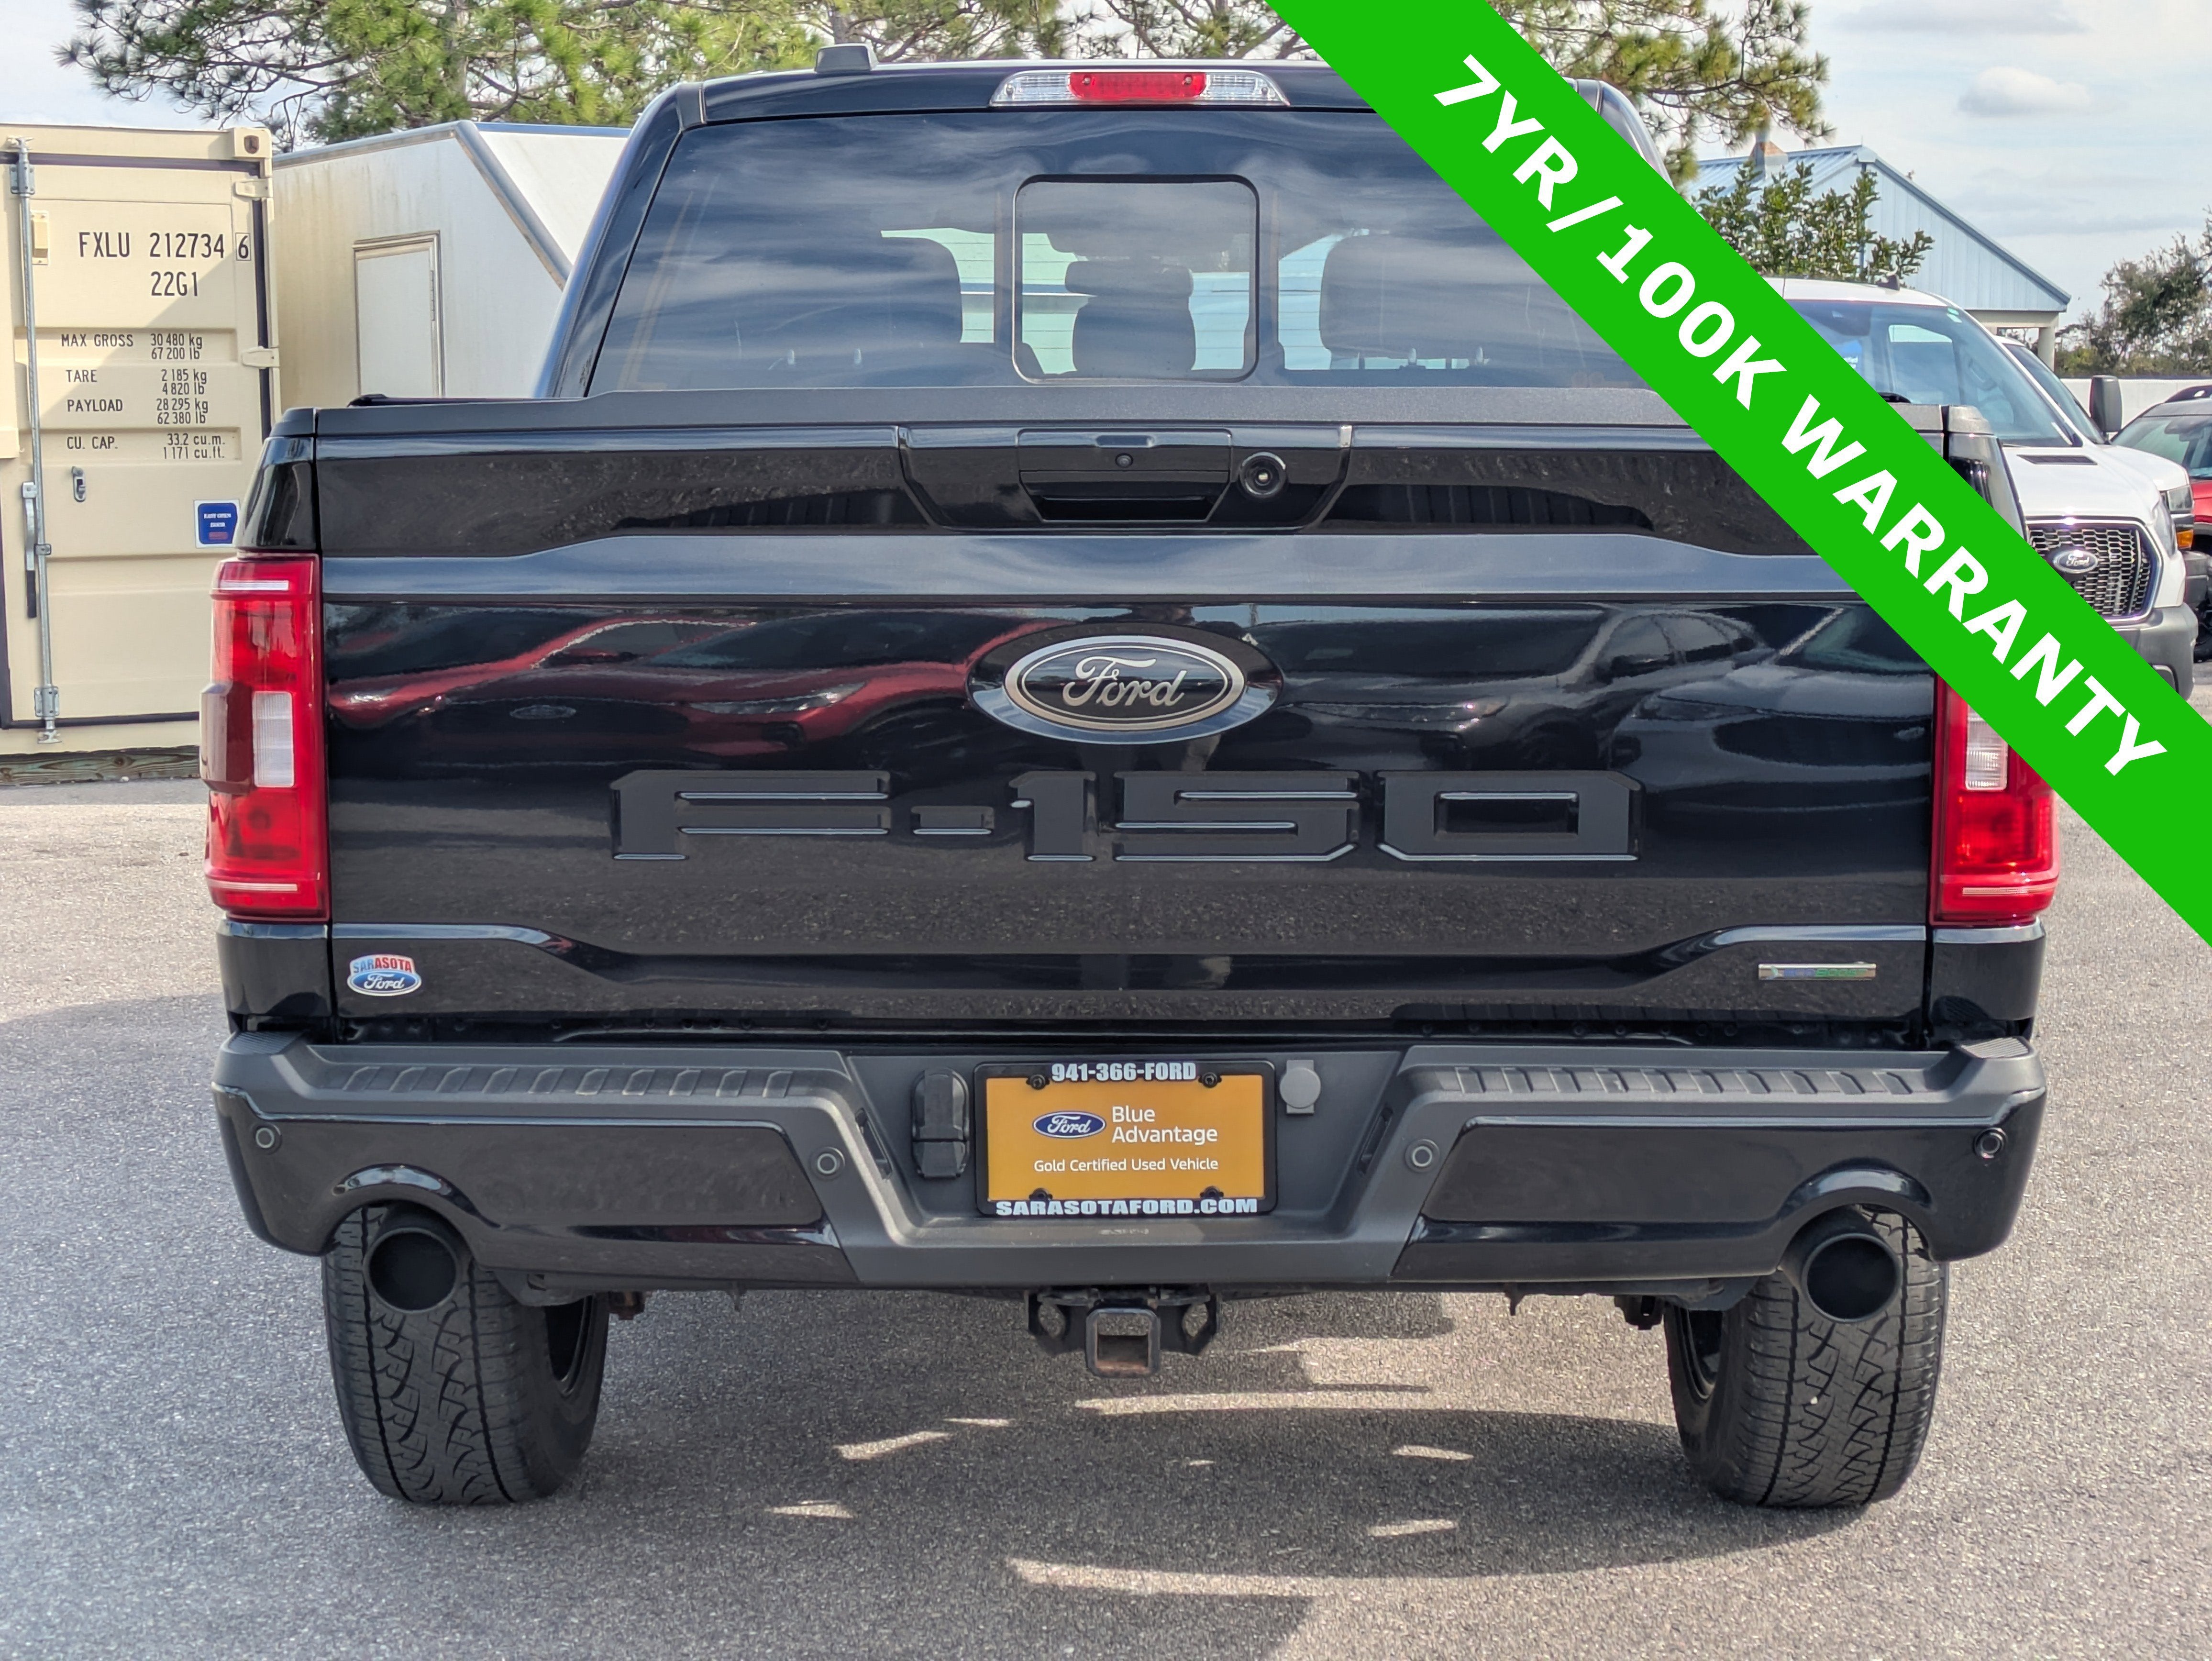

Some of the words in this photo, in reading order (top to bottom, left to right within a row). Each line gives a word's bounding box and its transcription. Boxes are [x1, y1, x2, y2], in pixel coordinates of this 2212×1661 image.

[79, 232, 130, 257] FXLU
[149, 233, 225, 258] 212734
[238, 235, 249, 258] 6
[150, 271, 198, 297] 22G1
[61, 333, 87, 347] MAX
[94, 333, 134, 347] GROSS
[188, 333, 202, 349] kg
[189, 347, 200, 360] lb
[65, 369, 98, 383] TARE
[192, 368, 207, 385] kg
[193, 383, 205, 395] lb
[66, 399, 123, 412] PAYLOAD
[194, 398, 209, 414] kg
[195, 412, 207, 424] lb
[66, 436, 86, 450] CU.
[91, 436, 119, 450] CAP.
[166, 432, 189, 446] 33.2
[2065, 554, 2090, 567] Ford
[1062, 655, 1188, 707] Ford
[610, 770, 1645, 862] F-150
[353, 957, 412, 973] SARASOTA
[364, 973, 406, 990] Ford
[1051, 1062, 1197, 1082] 941-366-FORD
[1111, 1105, 1156, 1123] Blue
[1047, 1115, 1092, 1134] Ford
[1111, 1125, 1218, 1146] Advantage
[1034, 1159, 1065, 1173] Gold
[1070, 1158, 1127, 1172] Certified
[1131, 1158, 1166, 1171] Used
[1170, 1158, 1219, 1171] Vehicle
[995, 1198, 1258, 1216] SARASOTAFORD.COM
